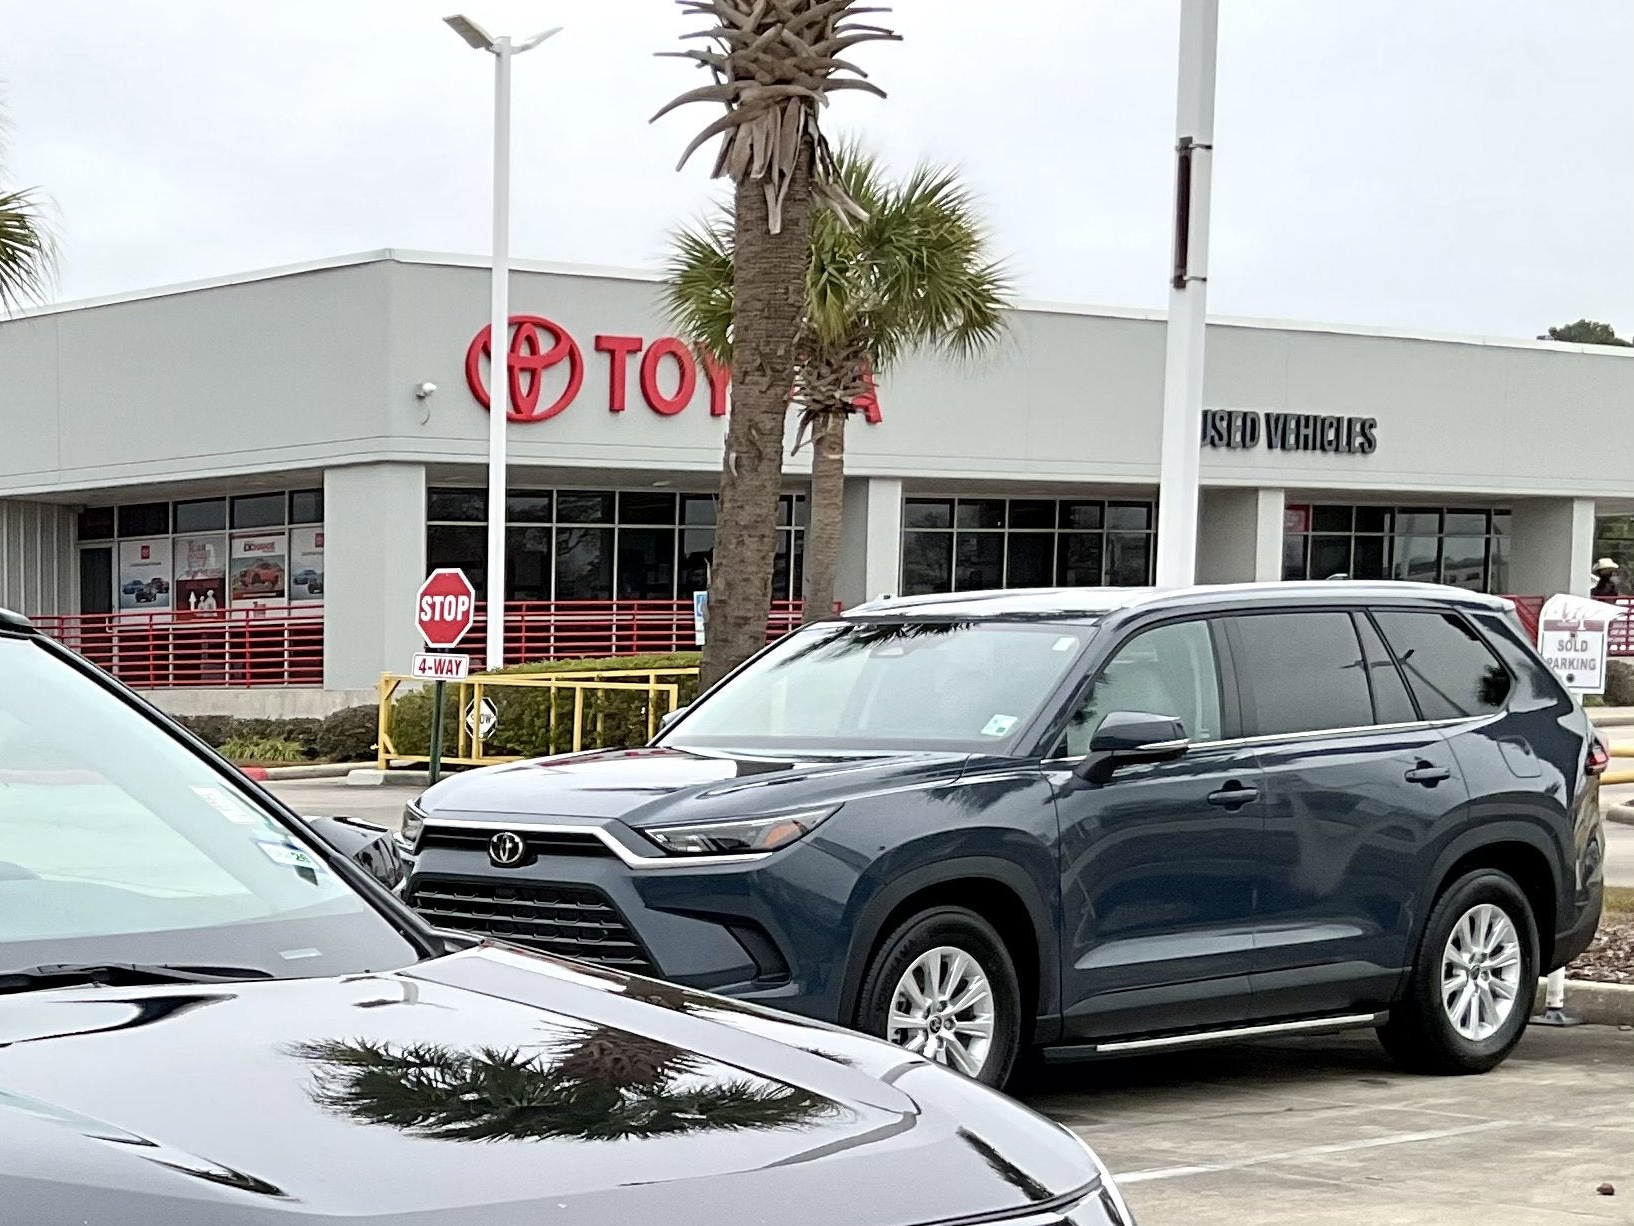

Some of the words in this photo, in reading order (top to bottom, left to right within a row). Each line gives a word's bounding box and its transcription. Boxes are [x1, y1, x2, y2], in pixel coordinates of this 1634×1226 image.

[595, 334, 883, 423] TOY
[1264, 412, 1378, 454] VEHICLES
[420, 595, 470, 622] STOP
[1557, 639, 1589, 653] SOLD
[418, 657, 463, 677] 4-WAY
[1546, 657, 1597, 671] PARKING
